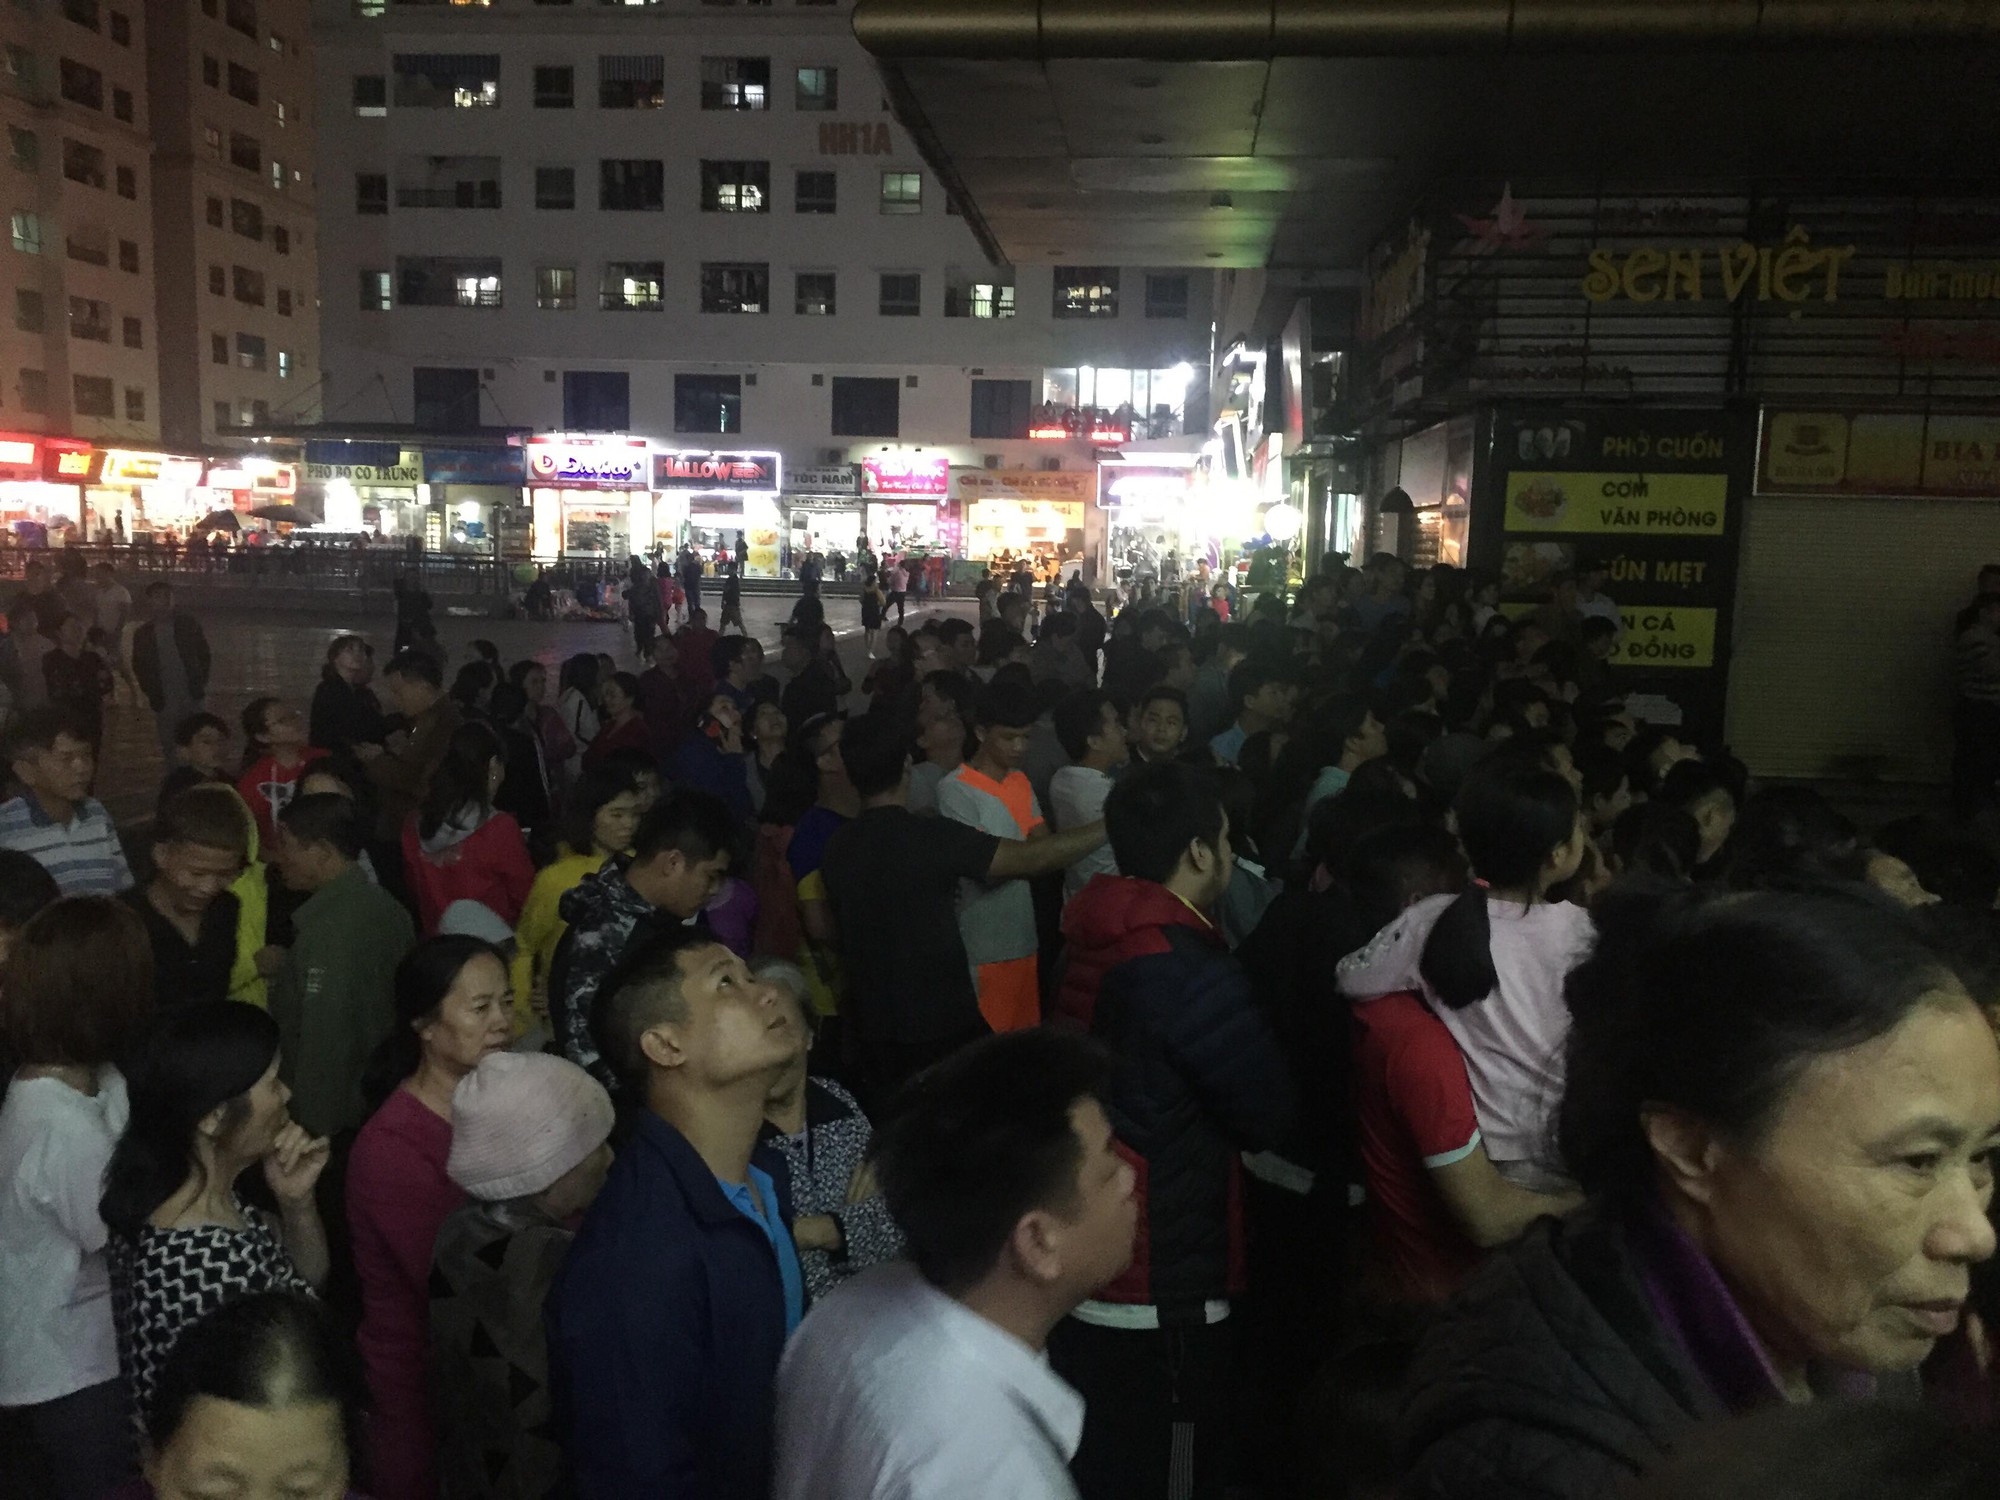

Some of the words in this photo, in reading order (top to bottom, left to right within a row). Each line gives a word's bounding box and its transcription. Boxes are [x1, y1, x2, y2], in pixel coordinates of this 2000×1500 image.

[657, 456, 768, 480] HALLOWEEN
[821, 474, 853, 485] NAM
[1601, 480, 1648, 498] CƠM
[1600, 506, 1640, 525] VĂN
[1646, 506, 1718, 527] PHÒNG
[1600, 554, 1647, 582] ÚN
[1655, 560, 1708, 589] MẸT
[1641, 611, 1676, 632] CÁ
